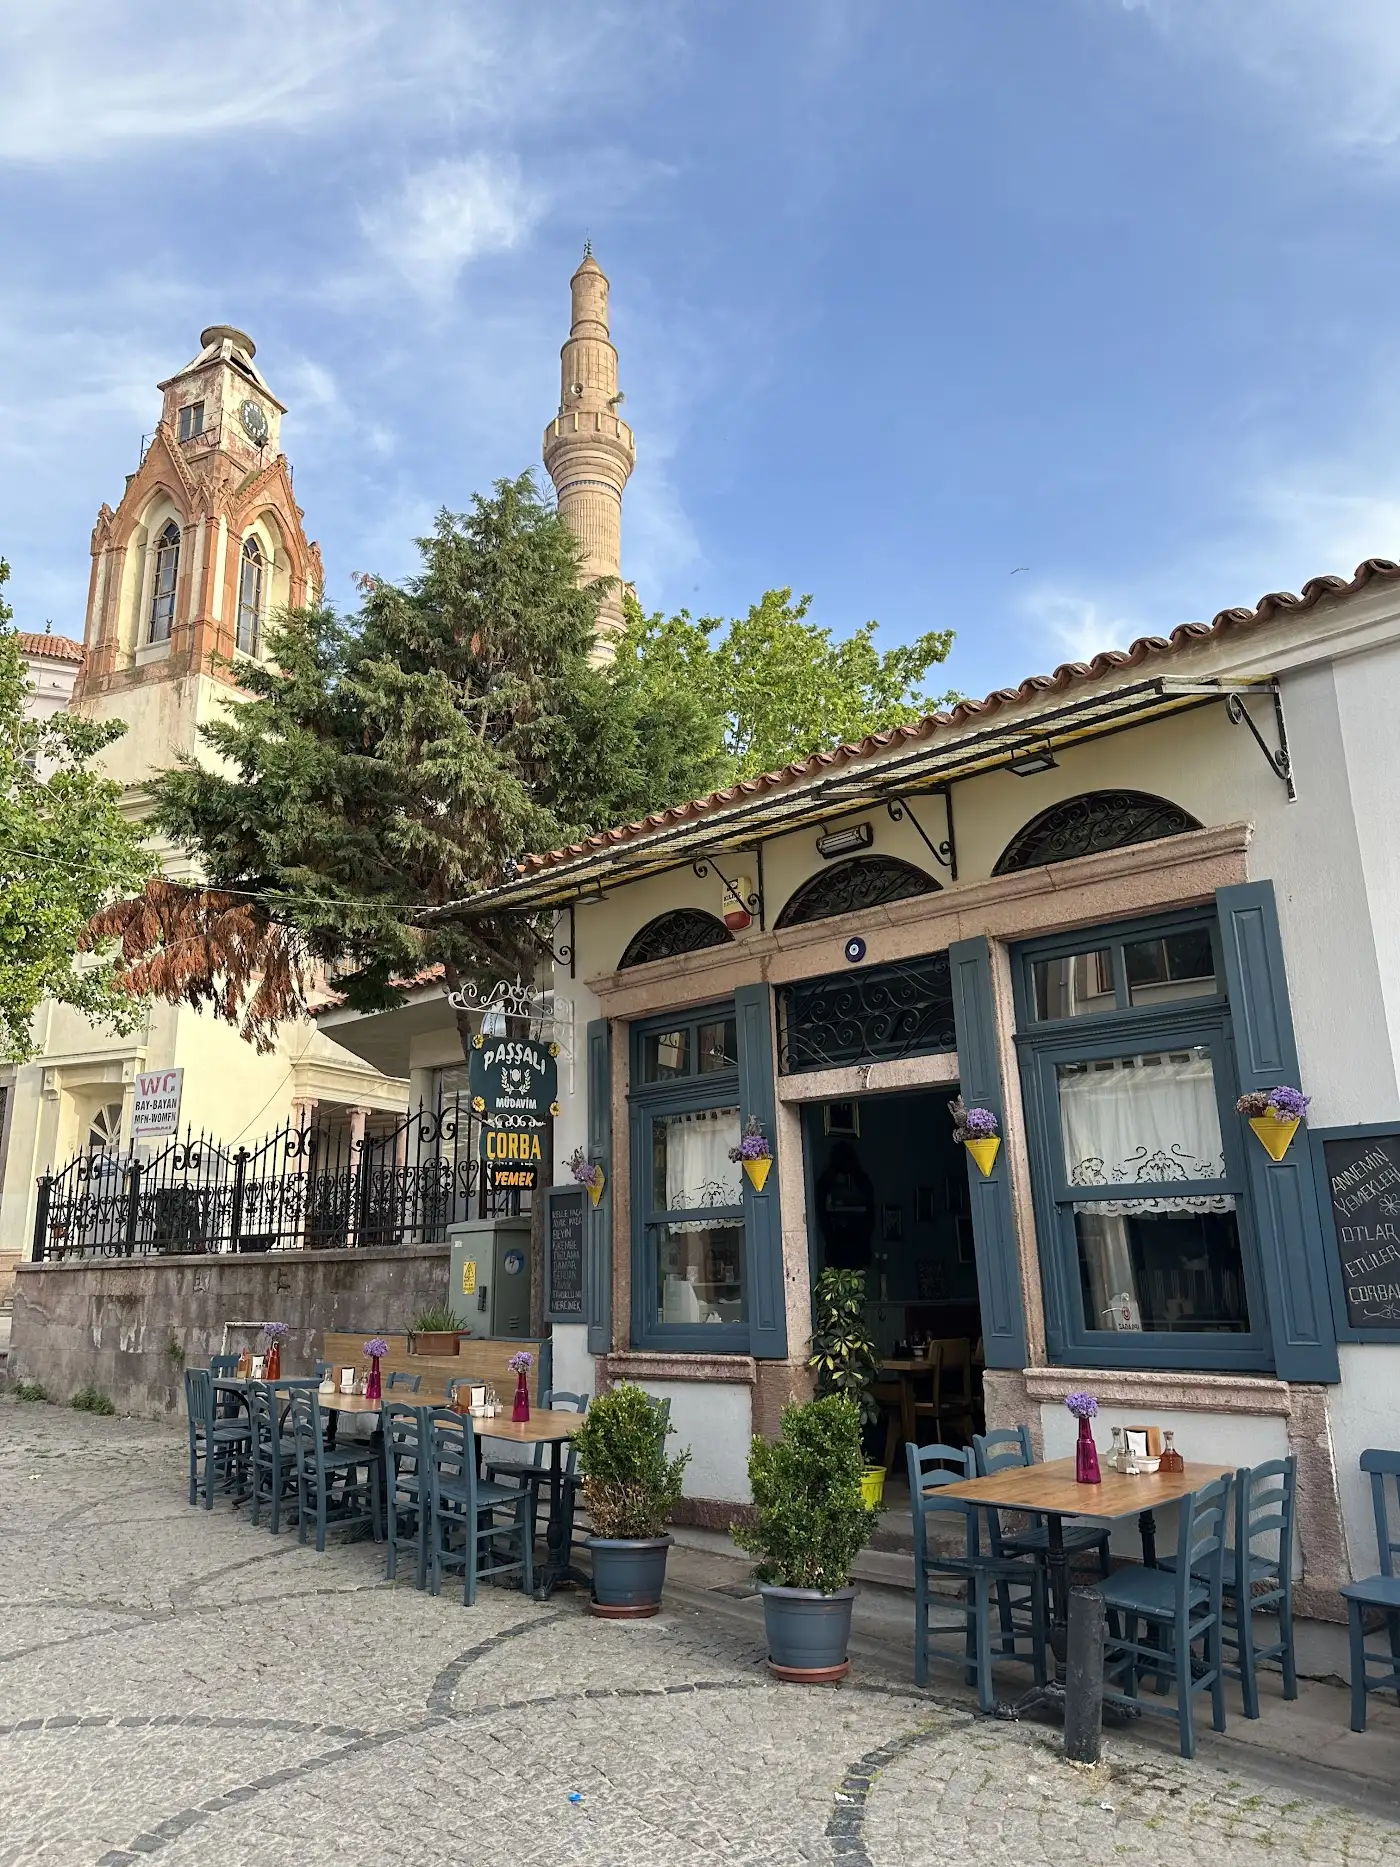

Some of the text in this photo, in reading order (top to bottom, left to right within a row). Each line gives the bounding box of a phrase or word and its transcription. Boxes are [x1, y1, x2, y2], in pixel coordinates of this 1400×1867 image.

[483, 1042, 546, 1075] PAŞŞALI
[139, 1072, 177, 1096] WC
[495, 1095, 537, 1109] MÜDAVİM
[486, 1131, 542, 1160] ÇORBA
[494, 1171, 535, 1187] YEMEK
[1331, 1145, 1389, 1195] ANNEMİN
[1341, 1223, 1400, 1244] OTLAR
[1345, 1245, 1400, 1278] ETLİLER
